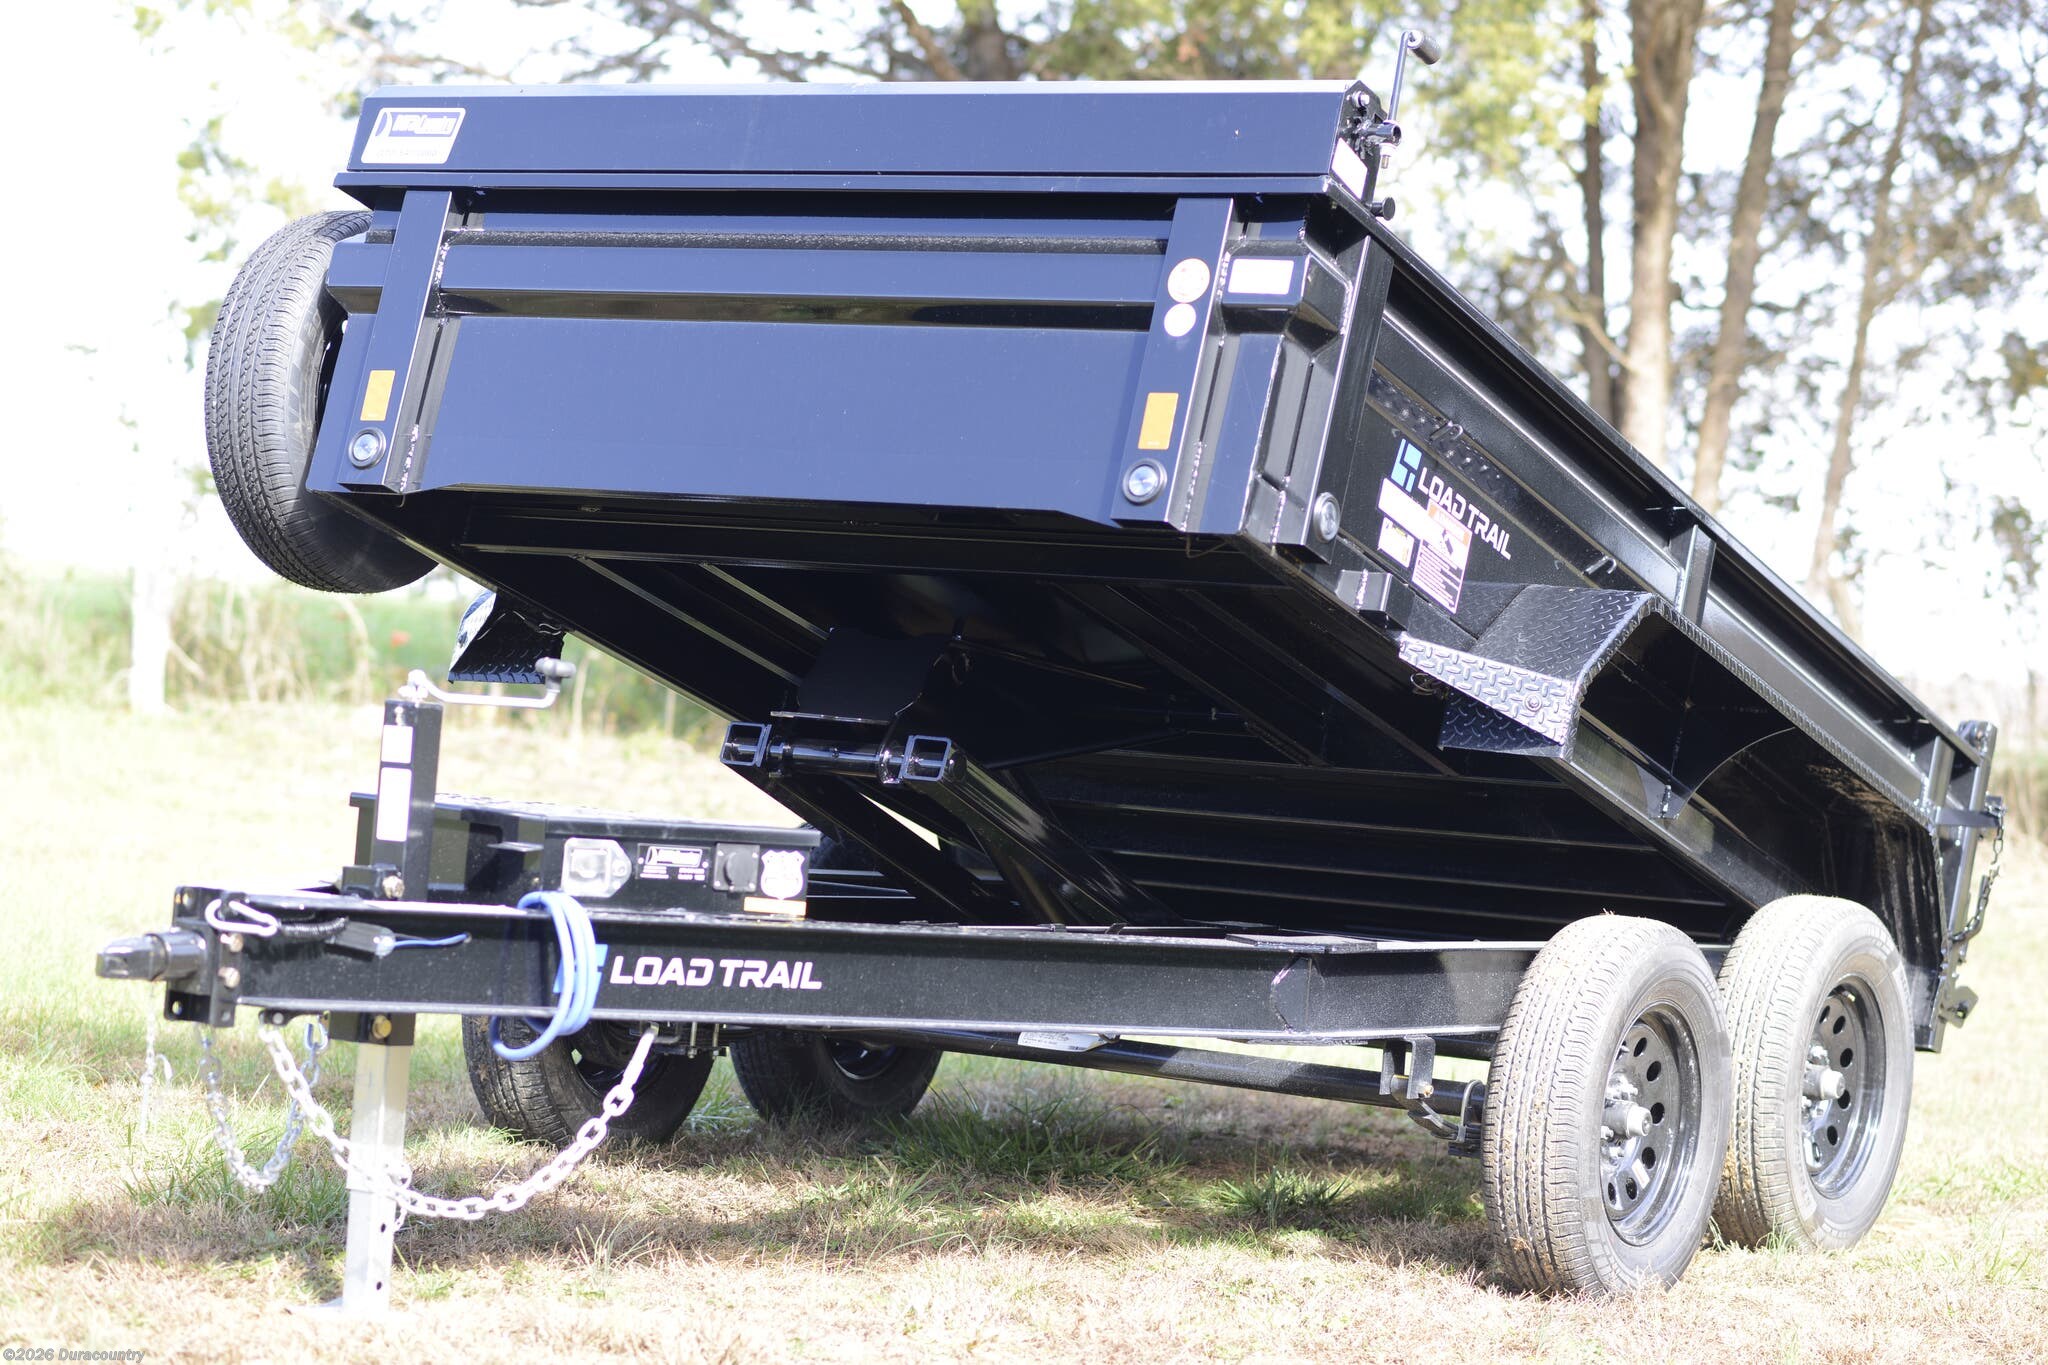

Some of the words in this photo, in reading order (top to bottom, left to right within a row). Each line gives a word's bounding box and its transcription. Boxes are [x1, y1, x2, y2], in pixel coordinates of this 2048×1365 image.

[1418, 466, 1467, 521] LOAD
[1467, 503, 1511, 560] TRAIL
[610, 955, 714, 987] LOAD
[719, 958, 822, 990] TRAIL
